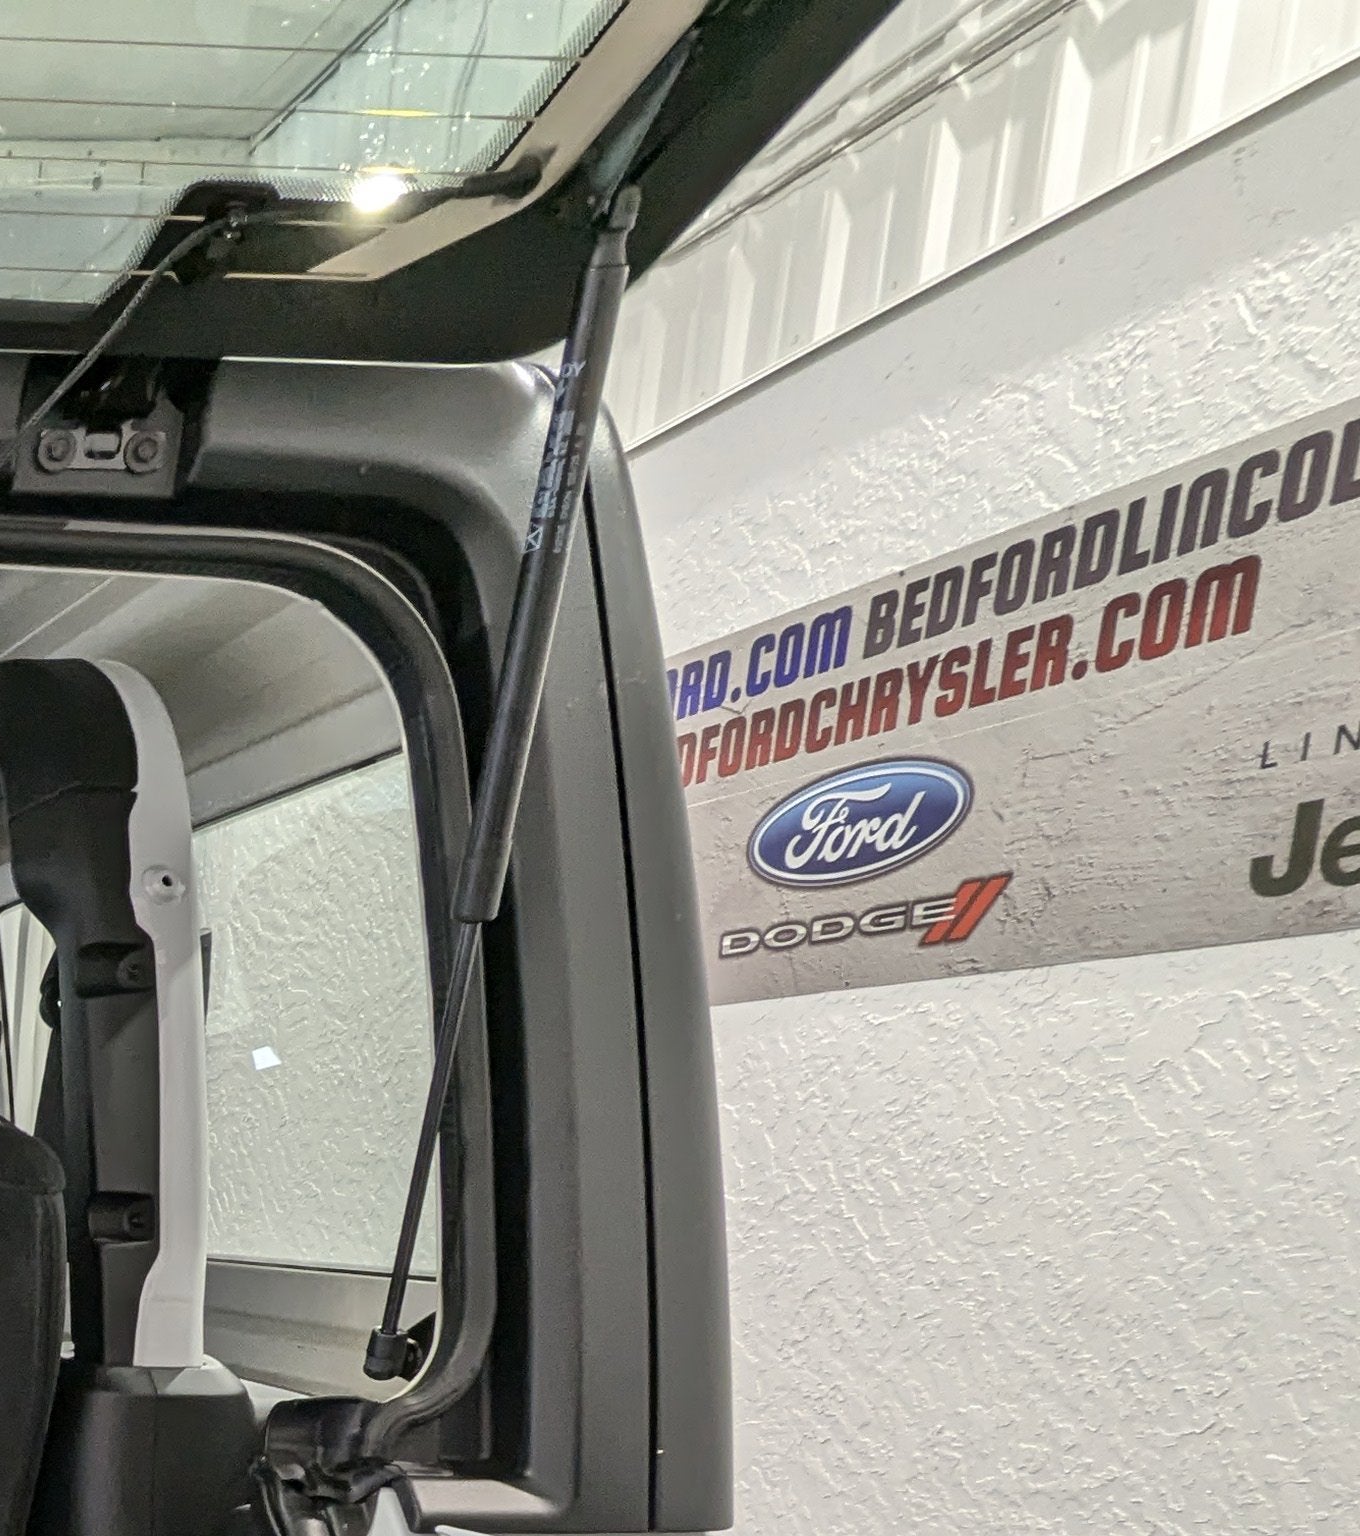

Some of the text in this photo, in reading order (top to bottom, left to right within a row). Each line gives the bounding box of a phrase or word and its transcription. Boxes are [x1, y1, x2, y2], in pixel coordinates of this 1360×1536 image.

[784, 782, 928, 871] Ford
[1248, 798, 1360, 897] Je
[719, 897, 959, 959] DODGE
